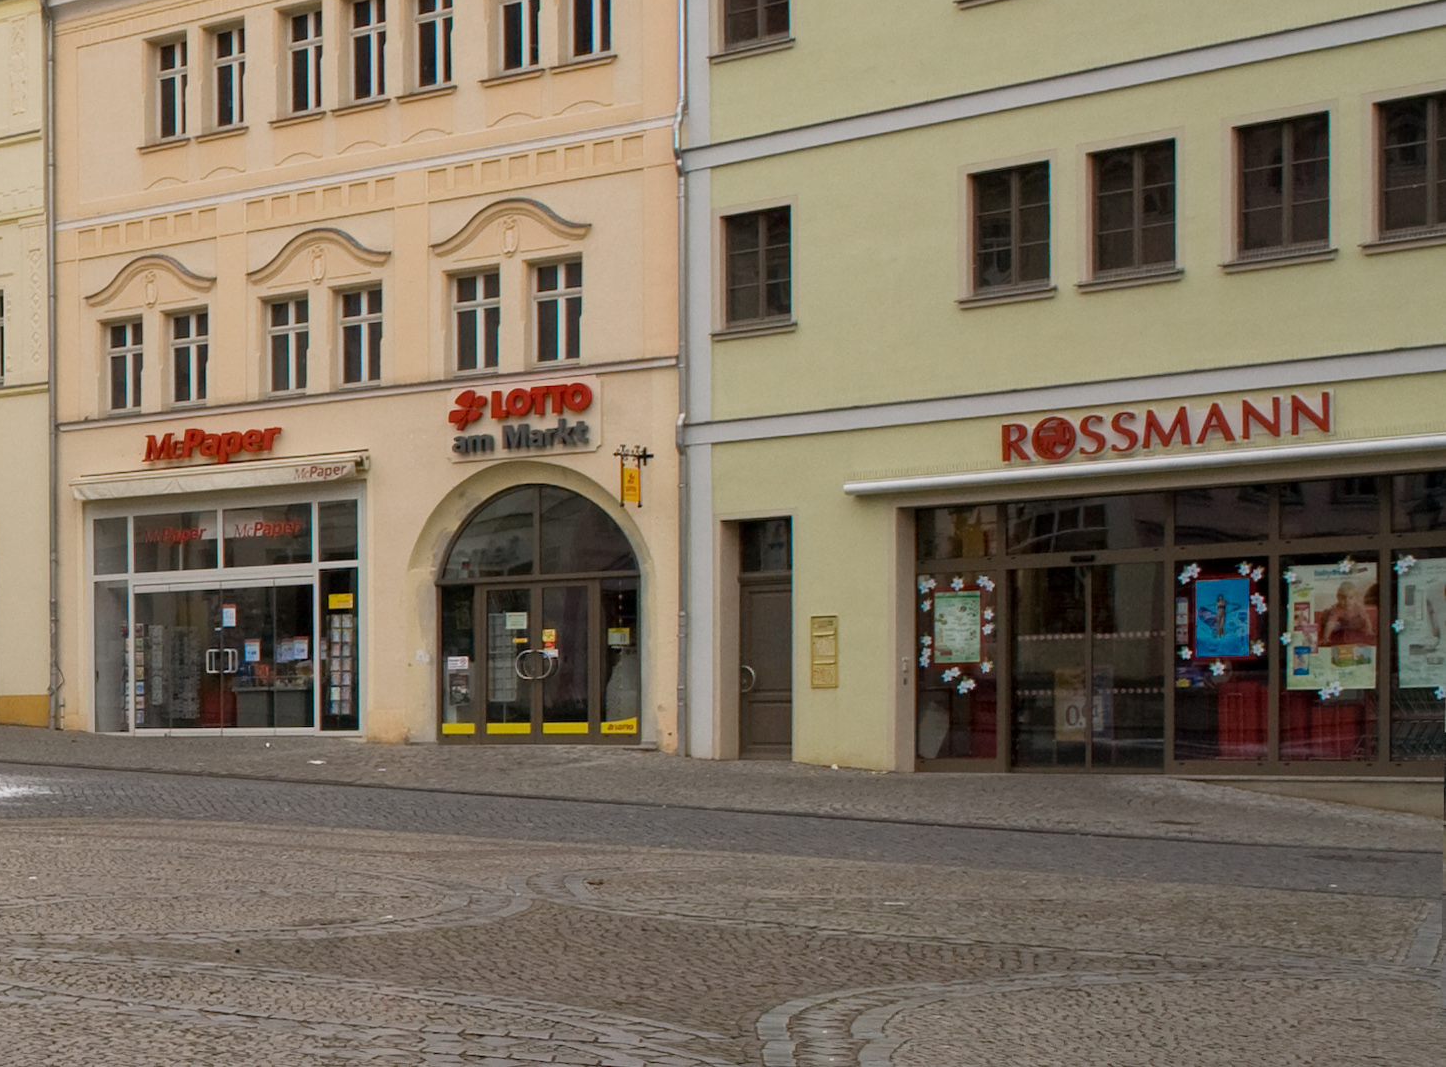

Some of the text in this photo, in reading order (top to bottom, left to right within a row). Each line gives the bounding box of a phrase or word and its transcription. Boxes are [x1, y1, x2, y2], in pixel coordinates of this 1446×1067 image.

[491, 382, 593, 419] LOTTO
[452, 418, 590, 455] am Markt
[1001, 391, 1331, 462] ROSSMANN
[142, 427, 282, 464] McPaper
[293, 465, 346, 481] McPaper
[233, 520, 302, 541] McPaper
